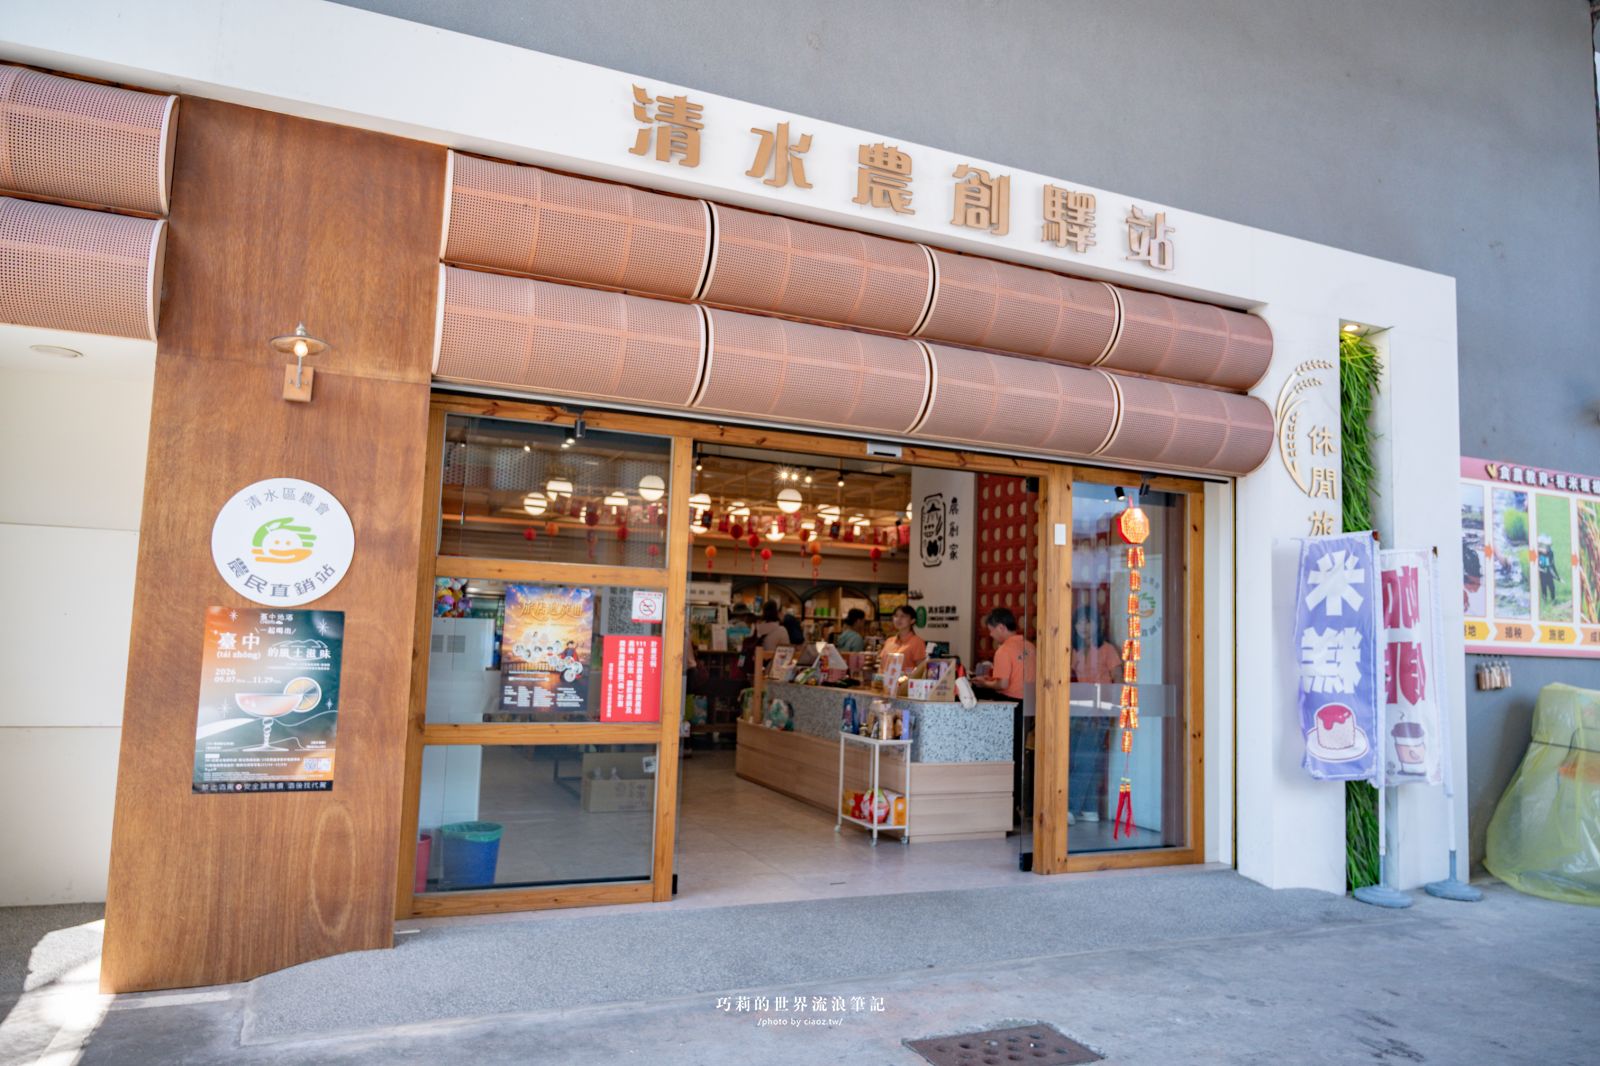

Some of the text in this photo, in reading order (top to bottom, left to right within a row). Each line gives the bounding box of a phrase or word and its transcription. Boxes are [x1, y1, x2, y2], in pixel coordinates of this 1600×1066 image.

[629, 83, 1176, 271] 清水農創驛站
[244, 487, 330, 515] 清水區農會
[227, 557, 336, 598] 農民直銷站
[217, 632, 260, 651] 臺中
[1464, 624, 1477, 636] 地
